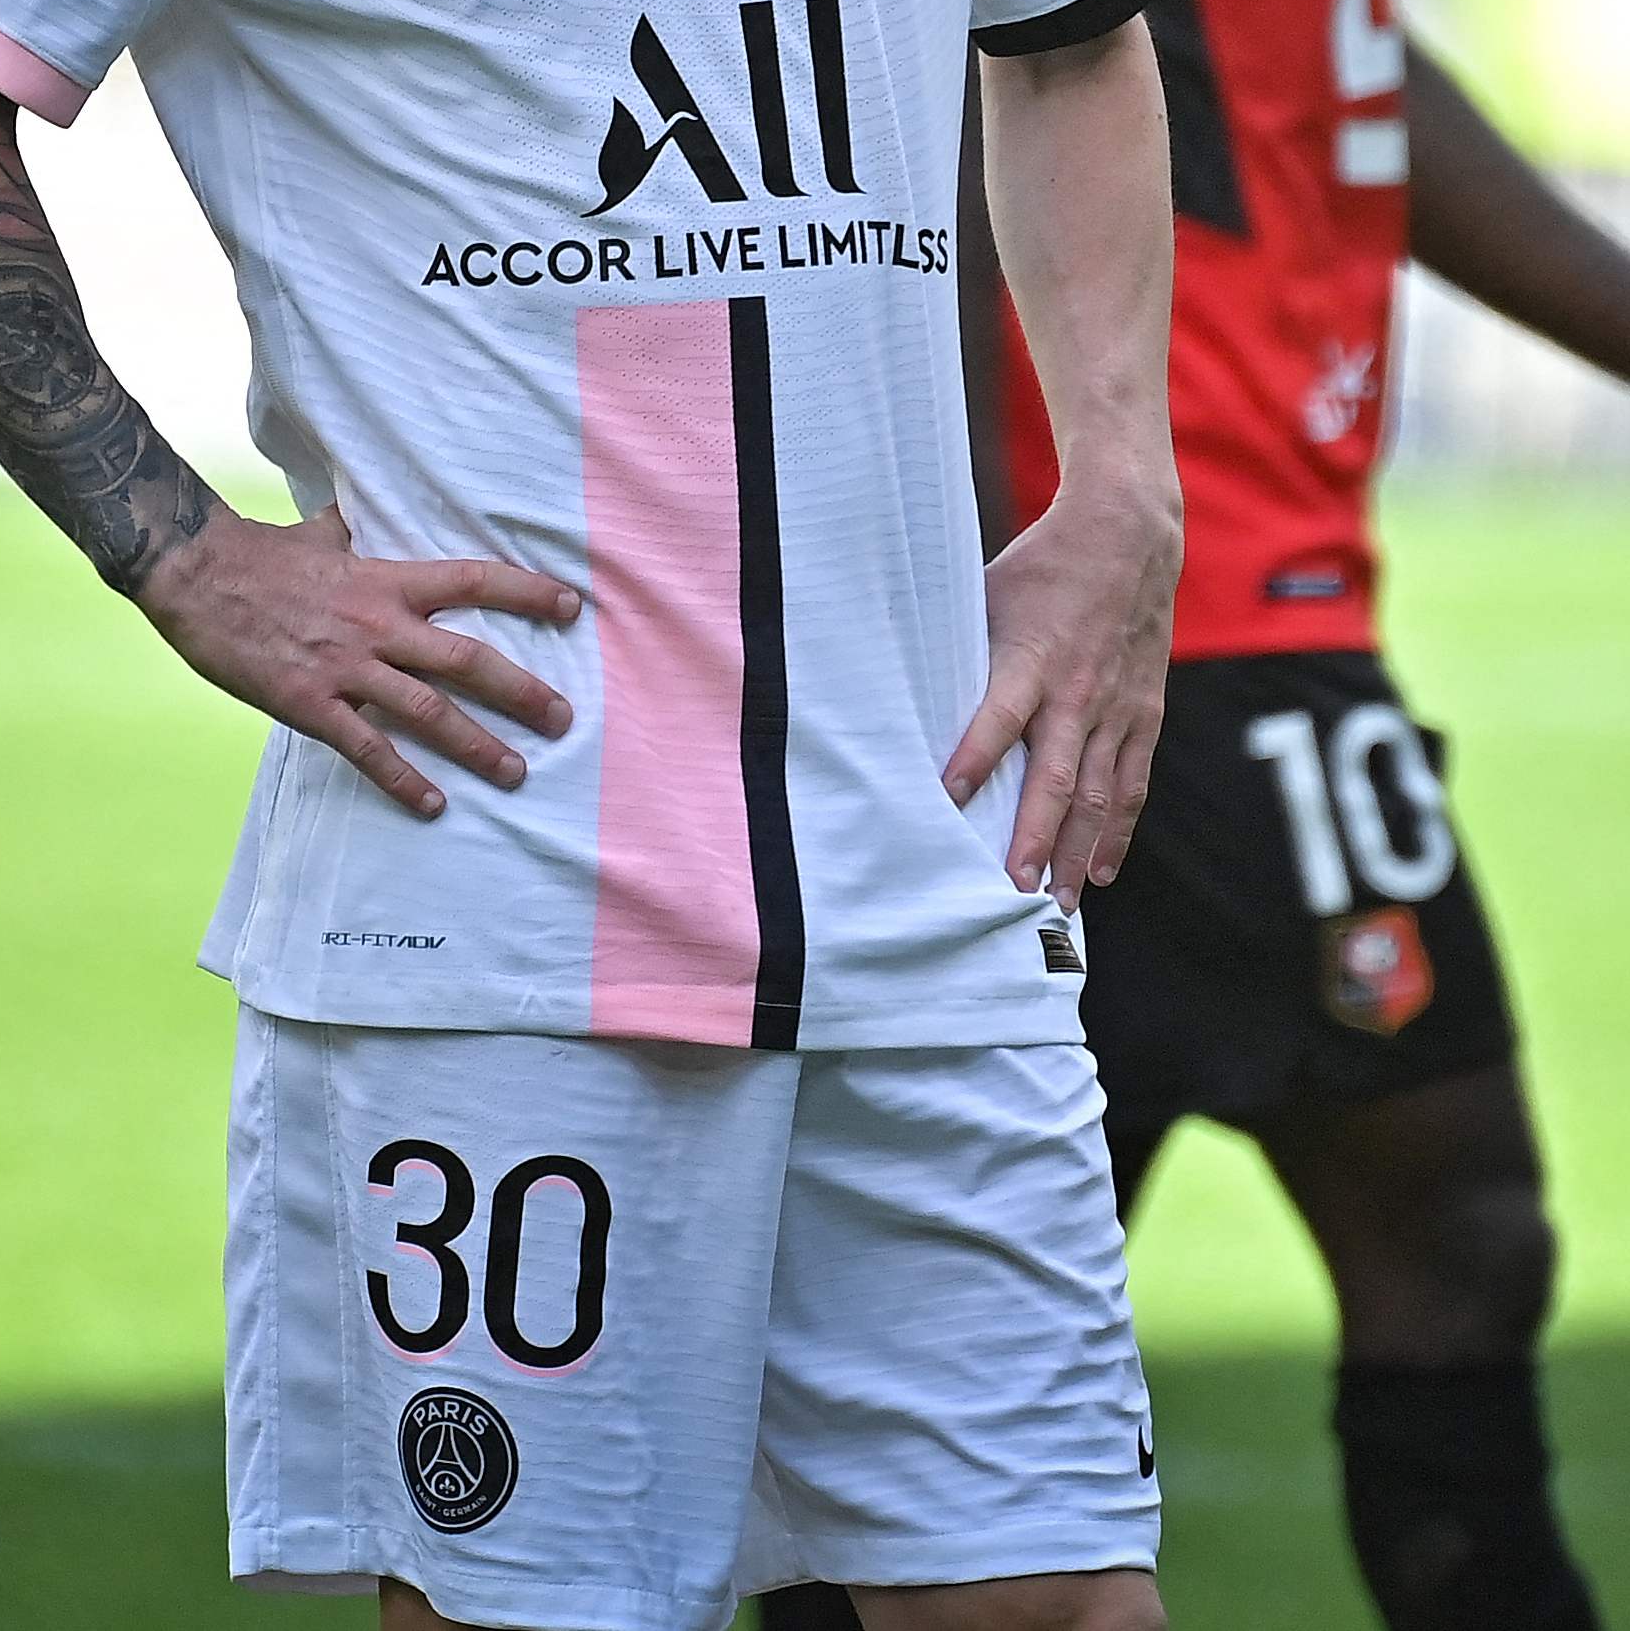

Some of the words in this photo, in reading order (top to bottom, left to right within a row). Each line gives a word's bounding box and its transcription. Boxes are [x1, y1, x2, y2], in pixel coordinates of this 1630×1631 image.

[421, 237, 635, 287] ACCOR
[653, 227, 765, 278] LIVE
[1241, 703, 1457, 918] 10
[366, 1139, 612, 1373] 30
[412, 1400, 489, 1436] PARIS
